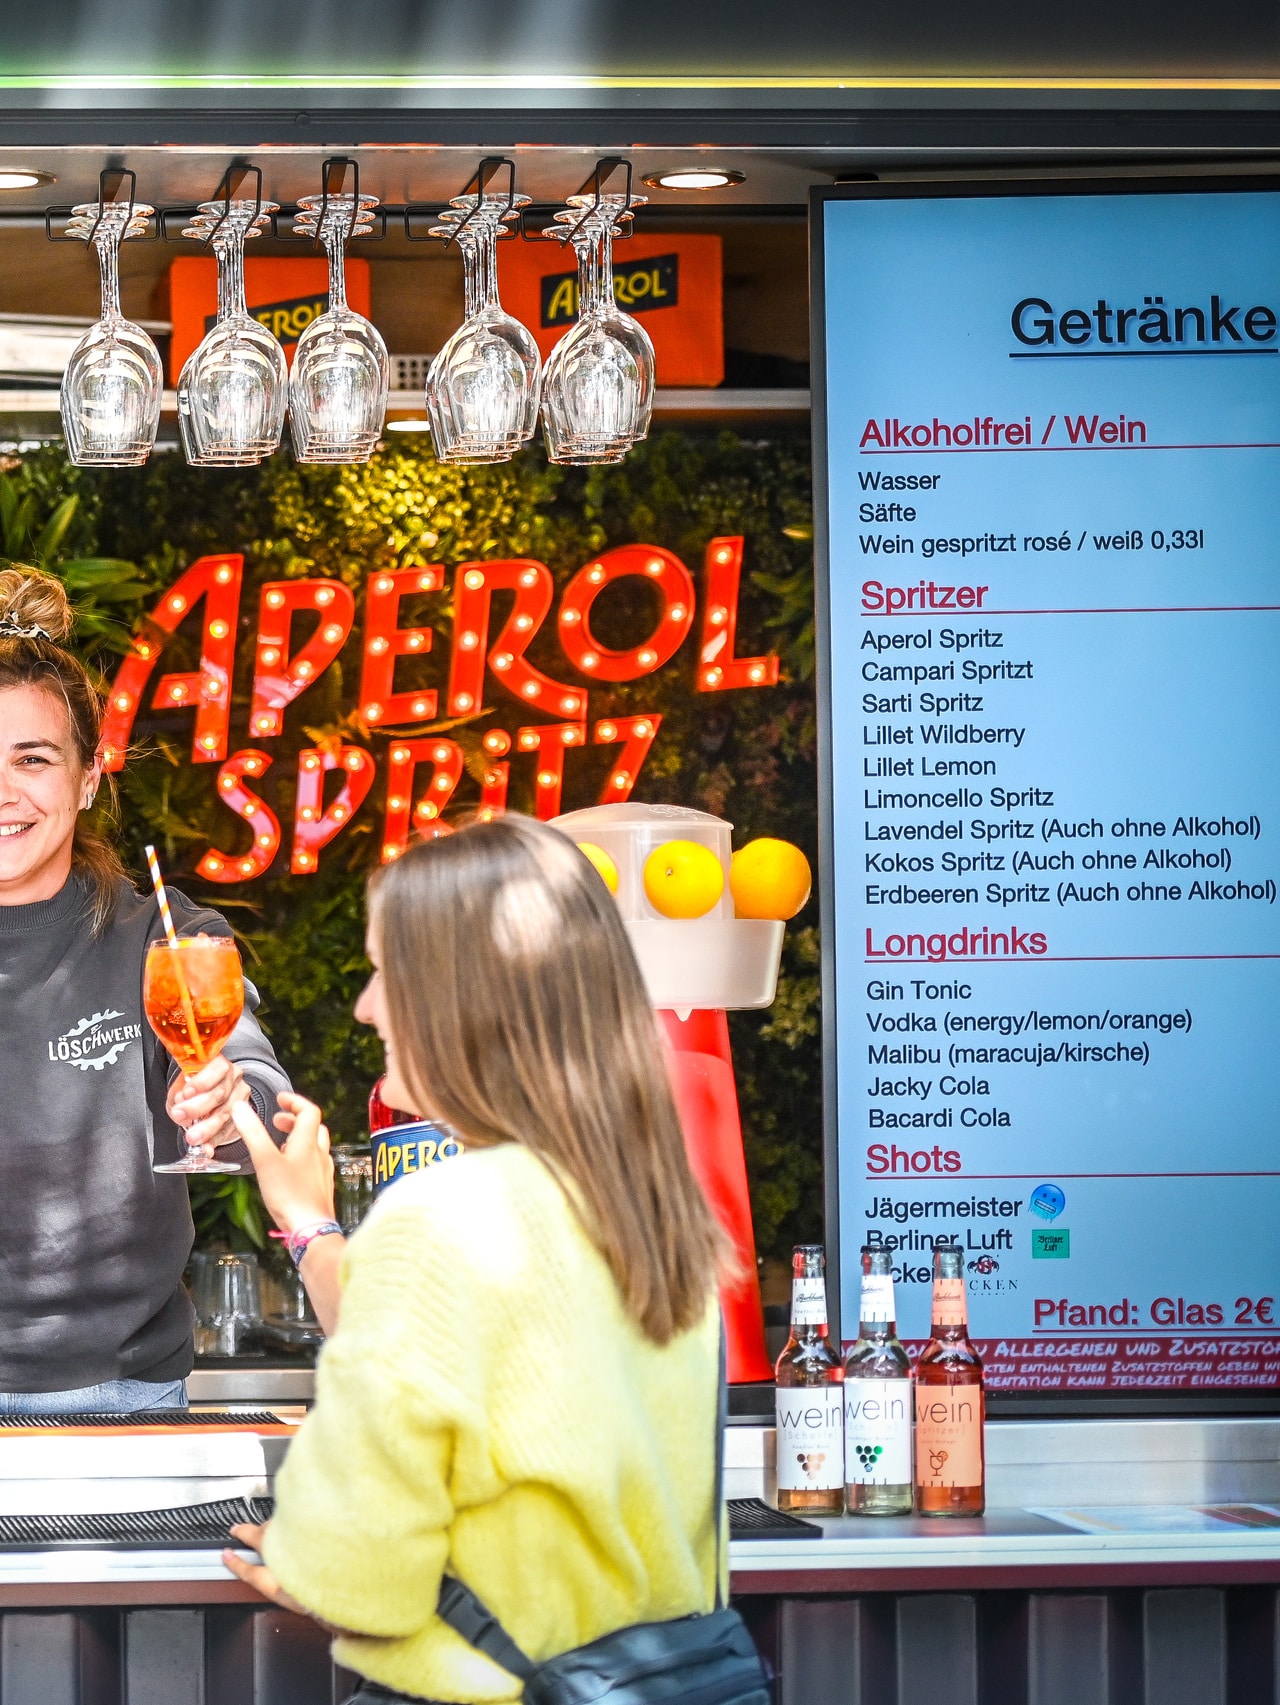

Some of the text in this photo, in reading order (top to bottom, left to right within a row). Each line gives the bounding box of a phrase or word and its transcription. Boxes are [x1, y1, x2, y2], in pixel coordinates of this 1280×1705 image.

[1011, 295, 1277, 345] Getränke
[859, 416, 1032, 448] Alkoholfrei
[1065, 414, 1147, 443] Wein
[858, 471, 940, 491] Wasser
[859, 502, 917, 522] Säfte
[859, 535, 914, 554] Wein
[921, 532, 1017, 558] gespritzt
[1023, 530, 1072, 551] rosé
[1093, 530, 1144, 550] weiß
[1151, 529, 1204, 554] 0,33l
[861, 580, 989, 614] Spritzer
[100, 535, 780, 773] APEROL
[861, 629, 1004, 654] Aperol Spritz
[861, 660, 1034, 686] Campari Spritzt
[862, 692, 984, 717] Sarti Spritz
[863, 724, 1026, 748] Lillet Wildberry
[864, 757, 996, 777] Lillet Lemon
[864, 786, 1054, 812] Limoncello Spritz
[865, 816, 1261, 844] Lavendel Spritz (Auch ohne Alkohol)
[865, 848, 1232, 876] Kokos Spritz (Auch ohne Alkohol)
[865, 880, 1277, 908] Erdbeeren Spritz (Auch ohne Alkohol)
[864, 926, 1048, 963] Longdrinks
[866, 979, 972, 1001] Gin Tonic
[866, 1009, 1193, 1036] Vodka (energy/lemon/orange)
[48, 1024, 142, 1061] LÖSCHWERK
[868, 1041, 1150, 1068] Malibu (maracuja/kirsche)
[867, 1075, 991, 1100] Jacky Cola
[869, 1107, 1011, 1129] Bacardi Cola
[375, 1137, 466, 1185] APERO
[866, 1144, 962, 1174] Shots
[865, 1196, 1024, 1224] Jägermeister
[866, 1228, 1013, 1251] Berliner Luft
[1034, 1296, 1274, 1326] Pfand: Glas 2€
[994, 1341, 1118, 1357] ALLERGENEN
[1126, 1342, 1161, 1356] UND
[1066, 1376, 1107, 1387] KANN
[778, 1406, 842, 1429] wein
